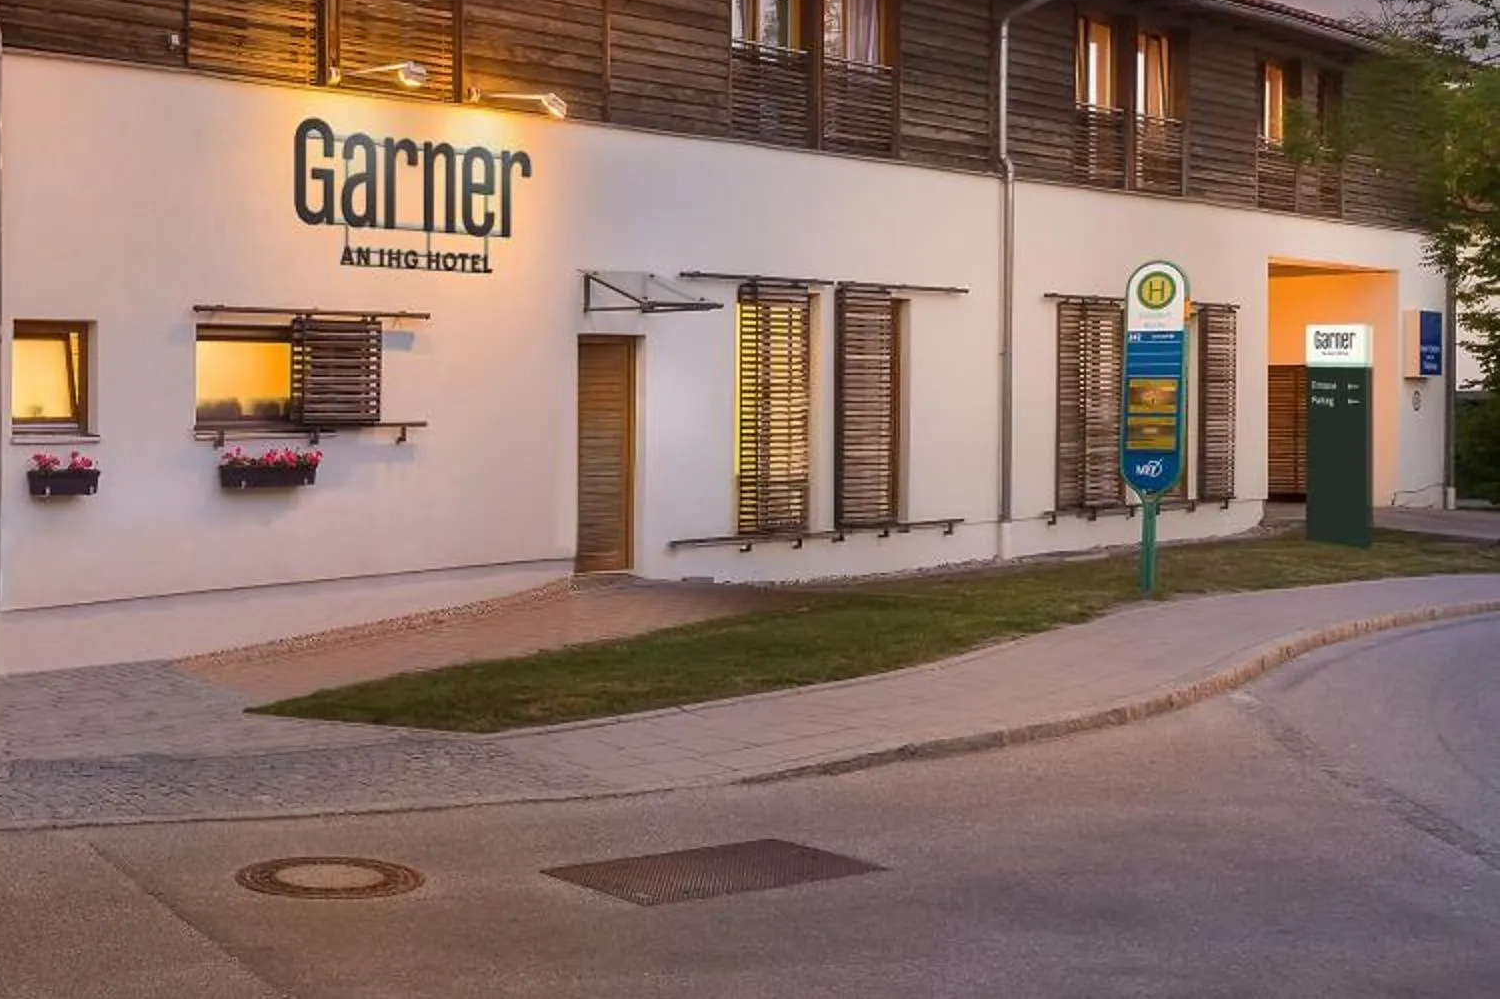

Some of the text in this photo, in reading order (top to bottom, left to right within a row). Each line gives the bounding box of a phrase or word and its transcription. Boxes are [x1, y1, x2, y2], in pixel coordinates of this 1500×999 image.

[293, 118, 531, 237] Garner
[340, 246, 493, 274] AN IHG HOTEL
[1148, 280, 1166, 302] H
[1314, 330, 1357, 350] Garner
